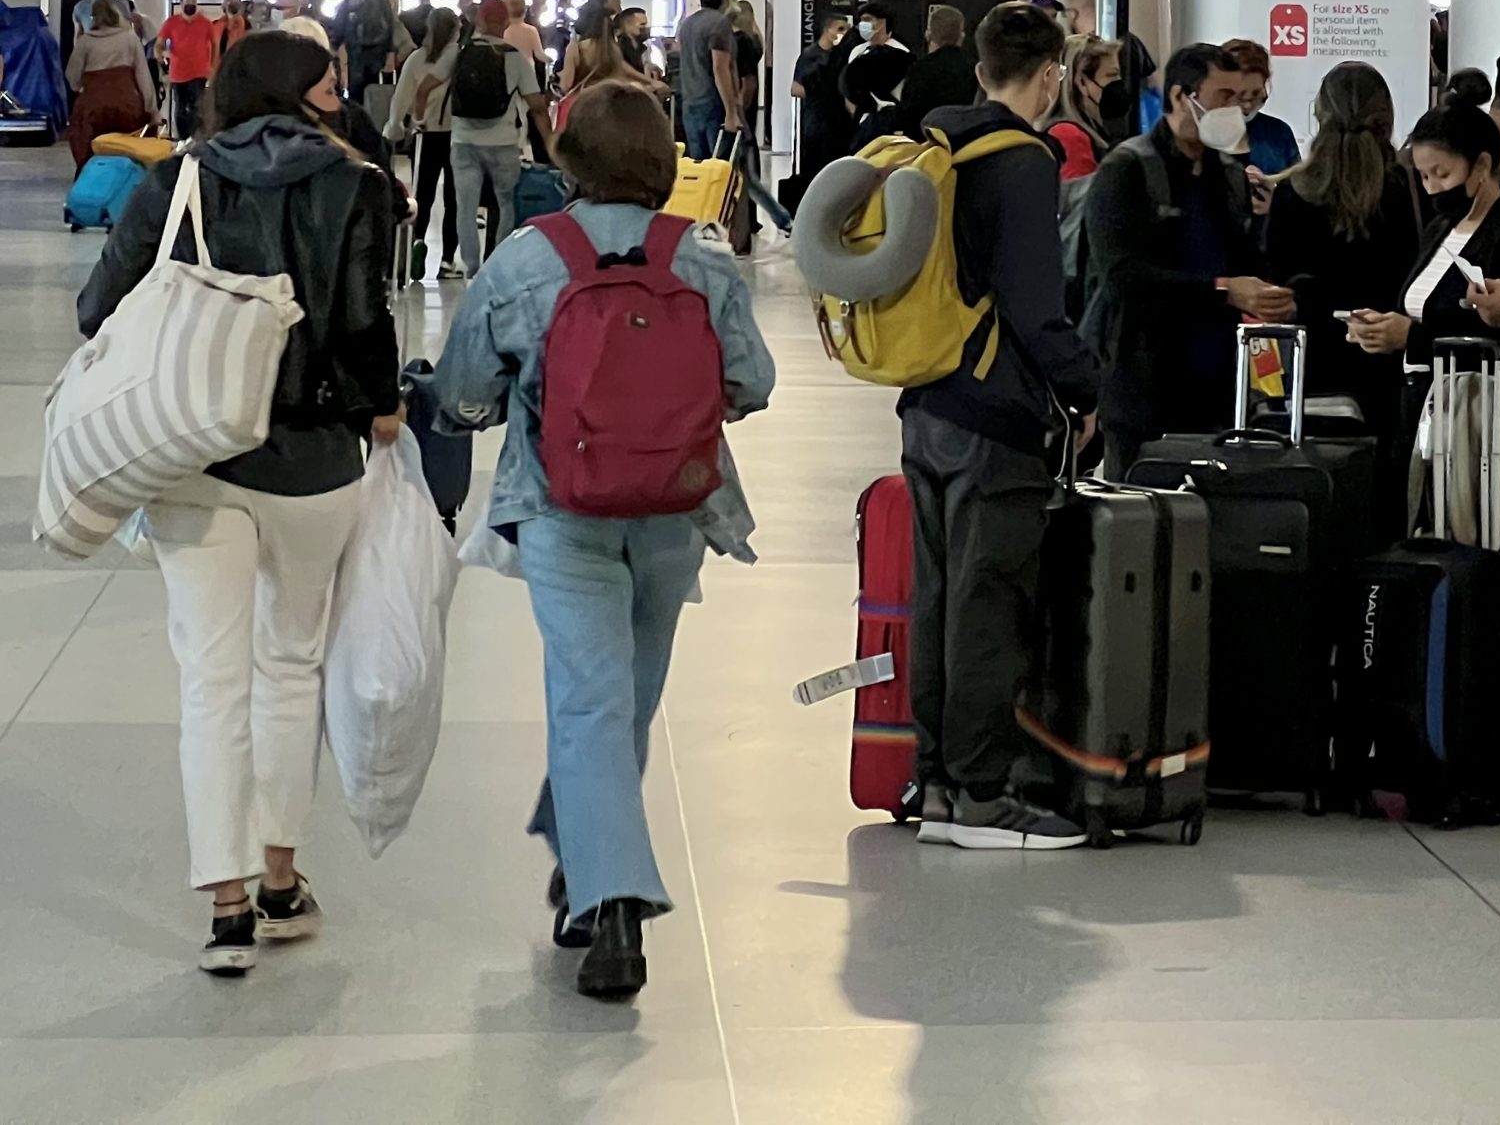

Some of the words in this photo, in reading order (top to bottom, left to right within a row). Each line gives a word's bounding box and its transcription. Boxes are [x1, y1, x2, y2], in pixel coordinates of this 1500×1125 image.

[1313, 4, 1329, 14] For
[1332, 4, 1352, 14] size
[1354, 5, 1369, 14] XS
[1371, 6, 1389, 15] one
[1313, 15, 1354, 28] personal
[1357, 16, 1378, 25] item
[1273, 25, 1305, 46] XS
[1313, 26, 1320, 35] is
[1322, 25, 1360, 35] allowed
[1362, 26, 1384, 36] with
[1313, 35, 1329, 45] the
[1331, 35, 1376, 48] following
[1363, 584, 1380, 669] NAUTICA
